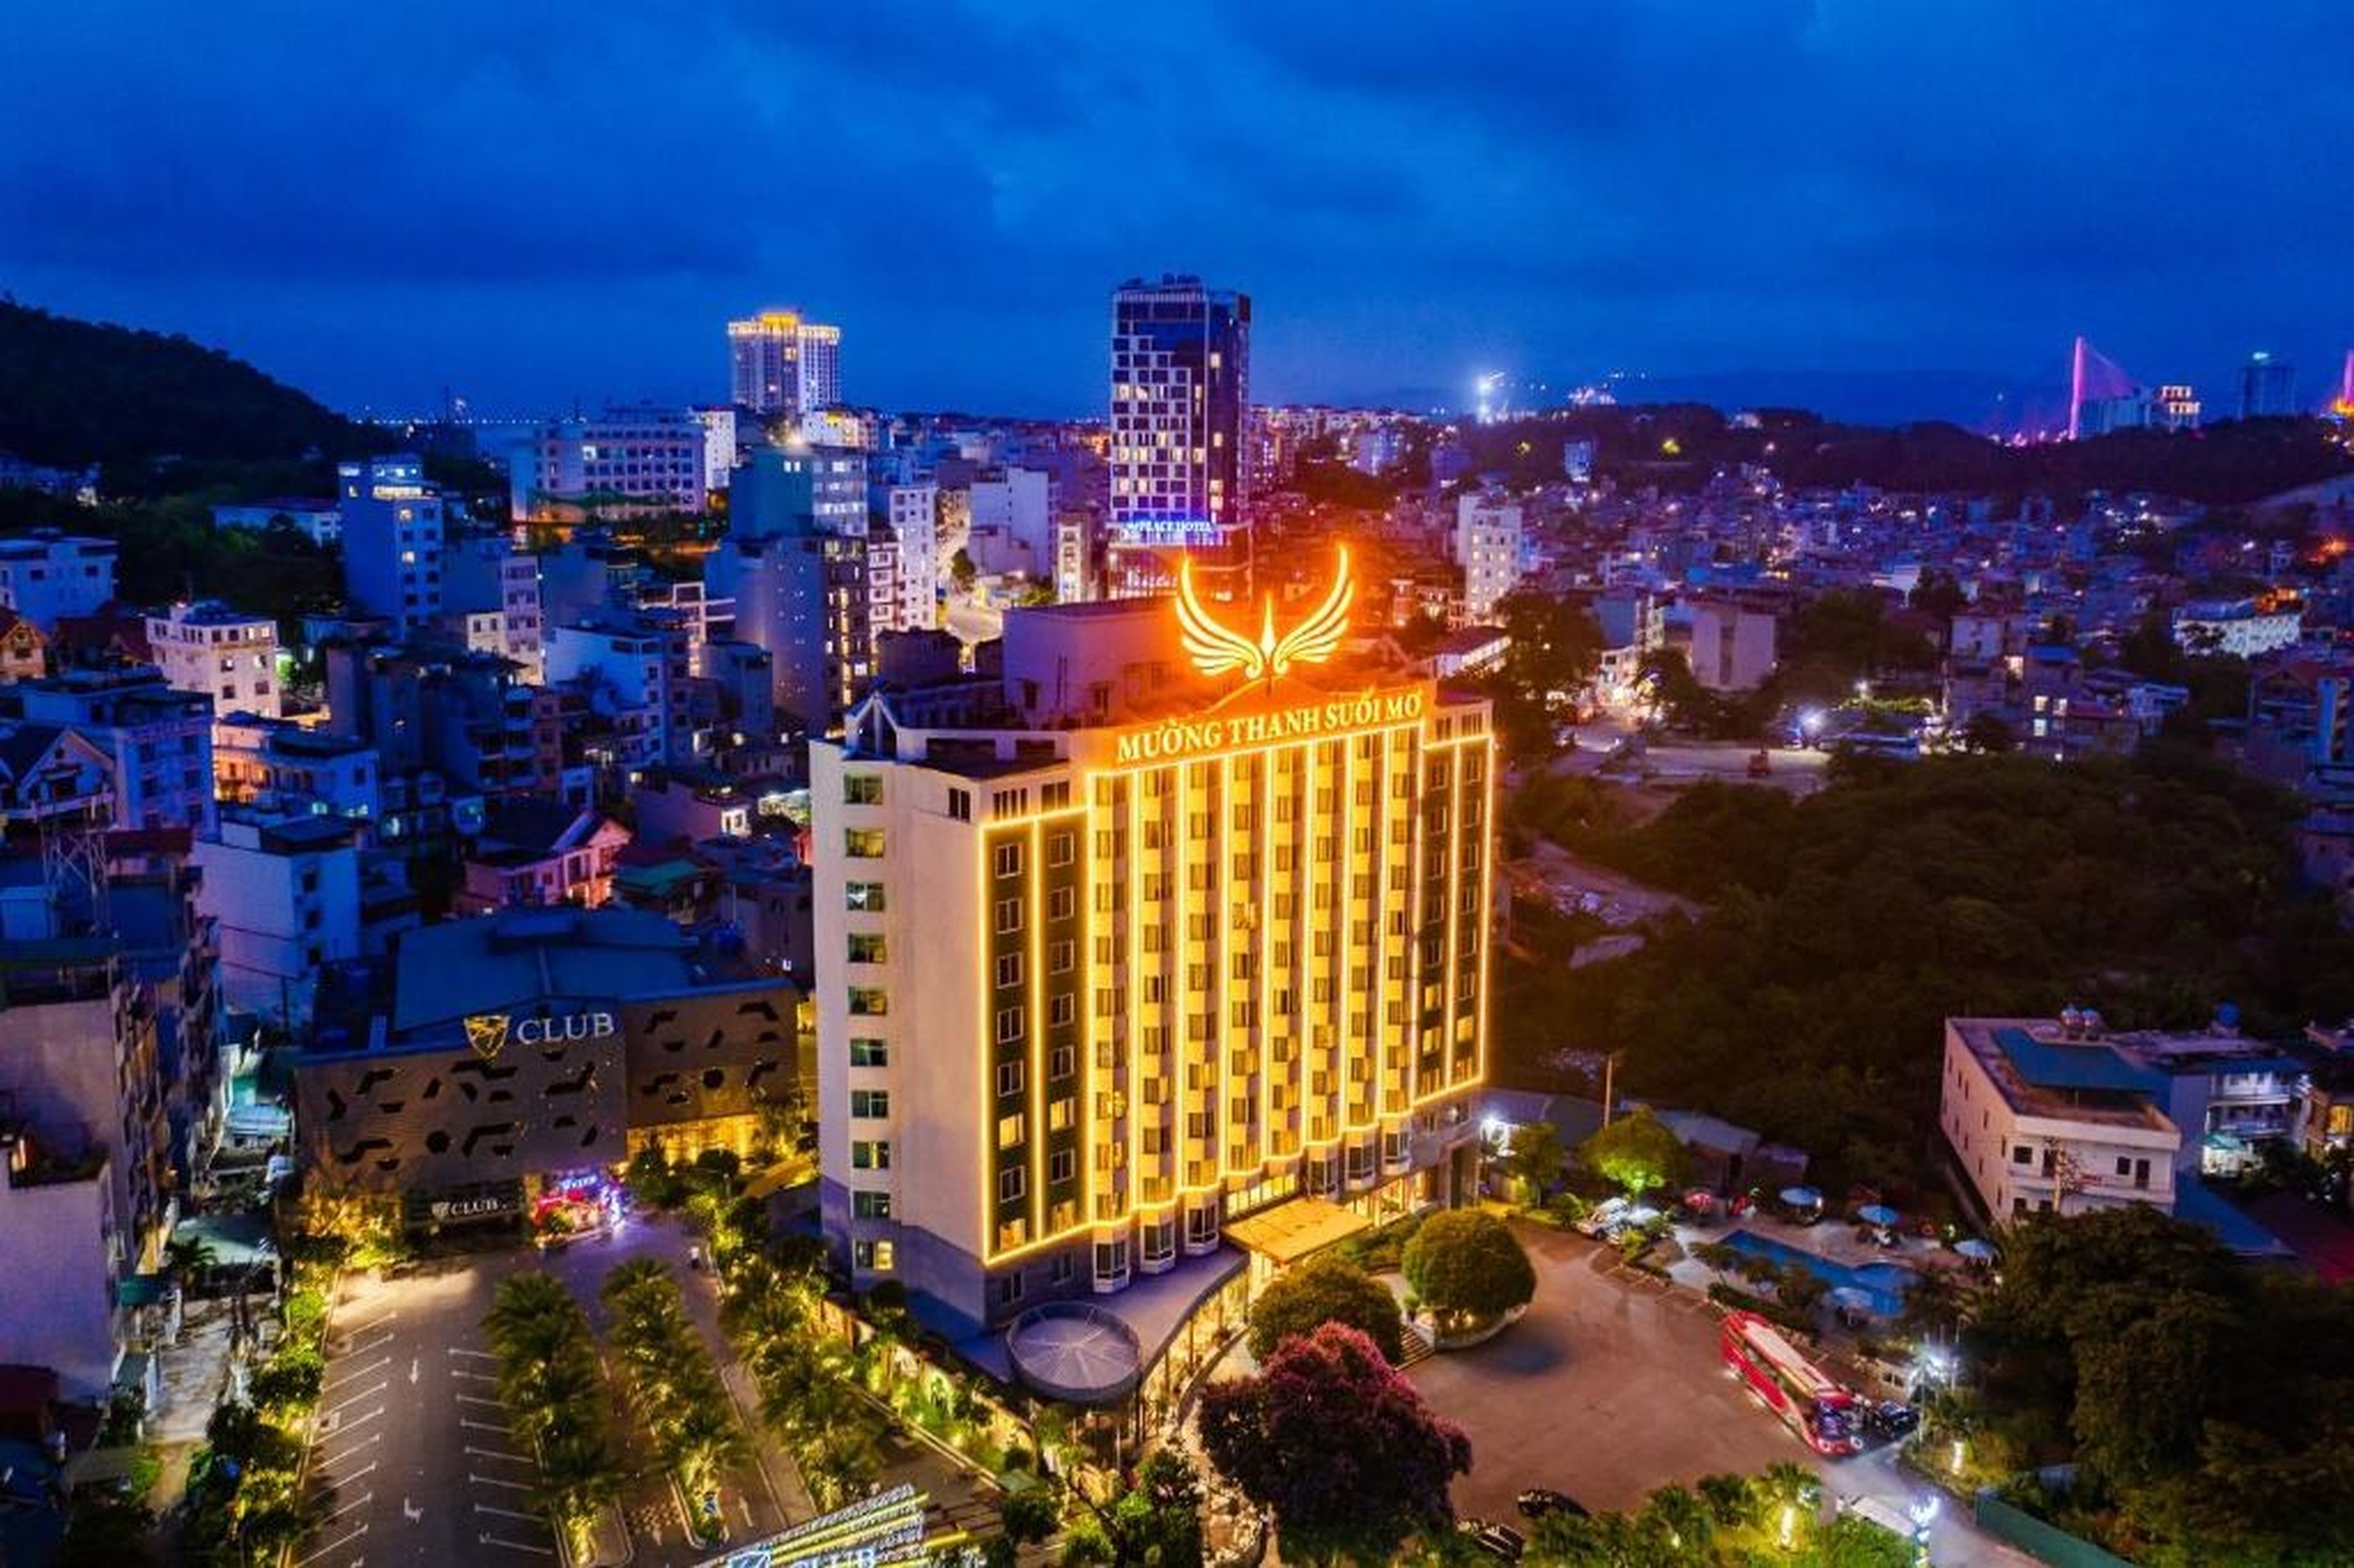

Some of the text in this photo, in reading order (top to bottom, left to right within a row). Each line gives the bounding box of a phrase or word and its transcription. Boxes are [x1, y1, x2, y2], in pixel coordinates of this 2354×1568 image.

[1117, 686, 1423, 764] MƯỜNG THANH SUỐI MƠ
[517, 1013, 614, 1045] CLUB
